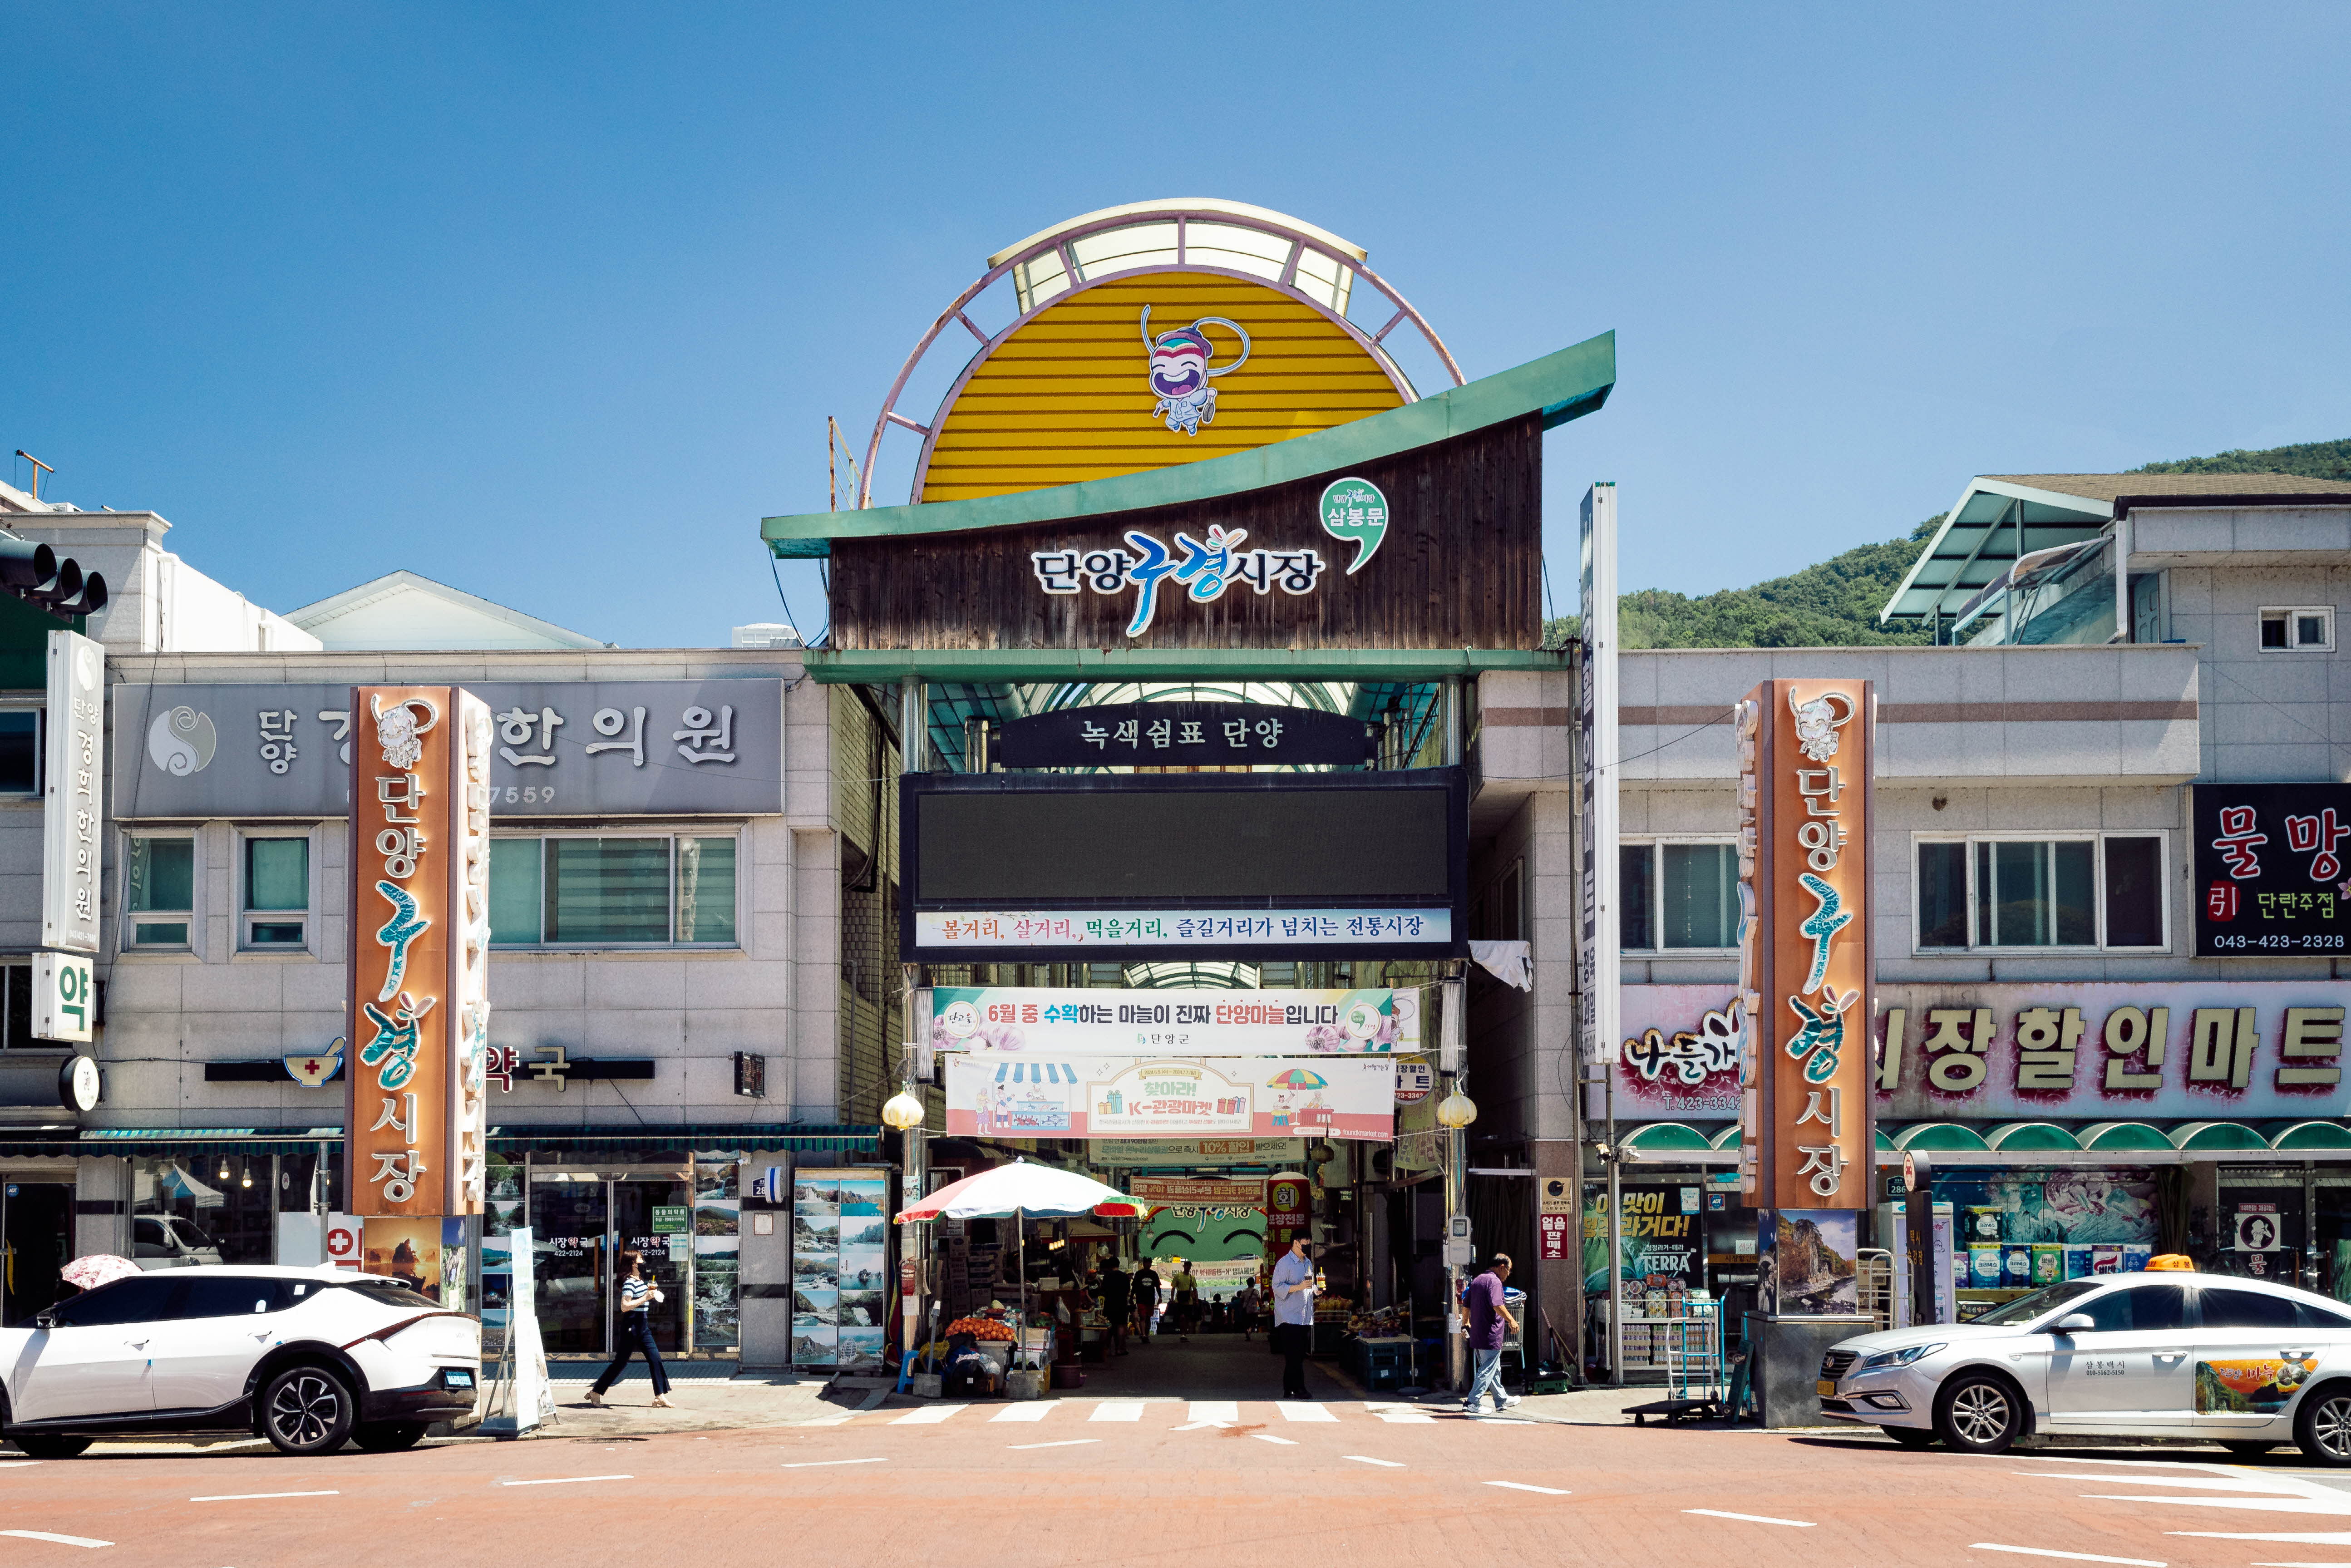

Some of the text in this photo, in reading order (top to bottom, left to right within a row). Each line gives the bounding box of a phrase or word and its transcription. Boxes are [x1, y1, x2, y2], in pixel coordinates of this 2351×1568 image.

[1327, 508, 1384, 526] 삼봉문
[1032, 525, 1325, 637] 단양구경시장
[74, 697, 99, 725] 단양
[259, 710, 298, 774] 단양
[1081, 718, 1284, 749] 녹색쉼표 단양
[75, 730, 95, 922] 경희한의원
[2212, 806, 2351, 882] 물망
[2209, 887, 2236, 916] 引
[2257, 892, 2334, 919] 단란주점
[942, 915, 1424, 942] 볼거리, 살거리, 먹을거리, 즐길거리가 넘치는 전통시장
[2214, 935, 2345, 948] 043-423-2328
[360, 773, 436, 1203] 단양구경시장
[1785, 766, 1860, 1196] 단양구경시장
[59, 966, 88, 1032] 약
[988, 1004, 1338, 1025] 6월 중 수확하는 마늘이 진짜 단양마늘입니다
[1151, 1033, 1190, 1045] 단양군
[1627, 1030, 1739, 1081] 나들가
[1144, 1081, 1197, 1096] 찾아라!
[1129, 1100, 1212, 1116] K-관광마켓
[1342, 1129, 1388, 1138] foundkmarket.com
[1203, 1141, 1226, 1154] 10%
[1228, 1140, 1250, 1153] 할인
[1255, 1142, 1286, 1152] 받으세요!
[1277, 1188, 1295, 1209] 회
[1622, 1193, 1665, 1214] 맛이
[1542, 1216, 1566, 1230] 얼음
[550, 1237, 588, 1249] 시장약국
[631, 1236, 670, 1248] 시장약국
[1546, 1231, 1562, 1258] 판매소
[1644, 1255, 1691, 1272] TERRA
[2248, 1254, 2267, 1275] 물
[2247, 1363, 2275, 1381] 마늘
